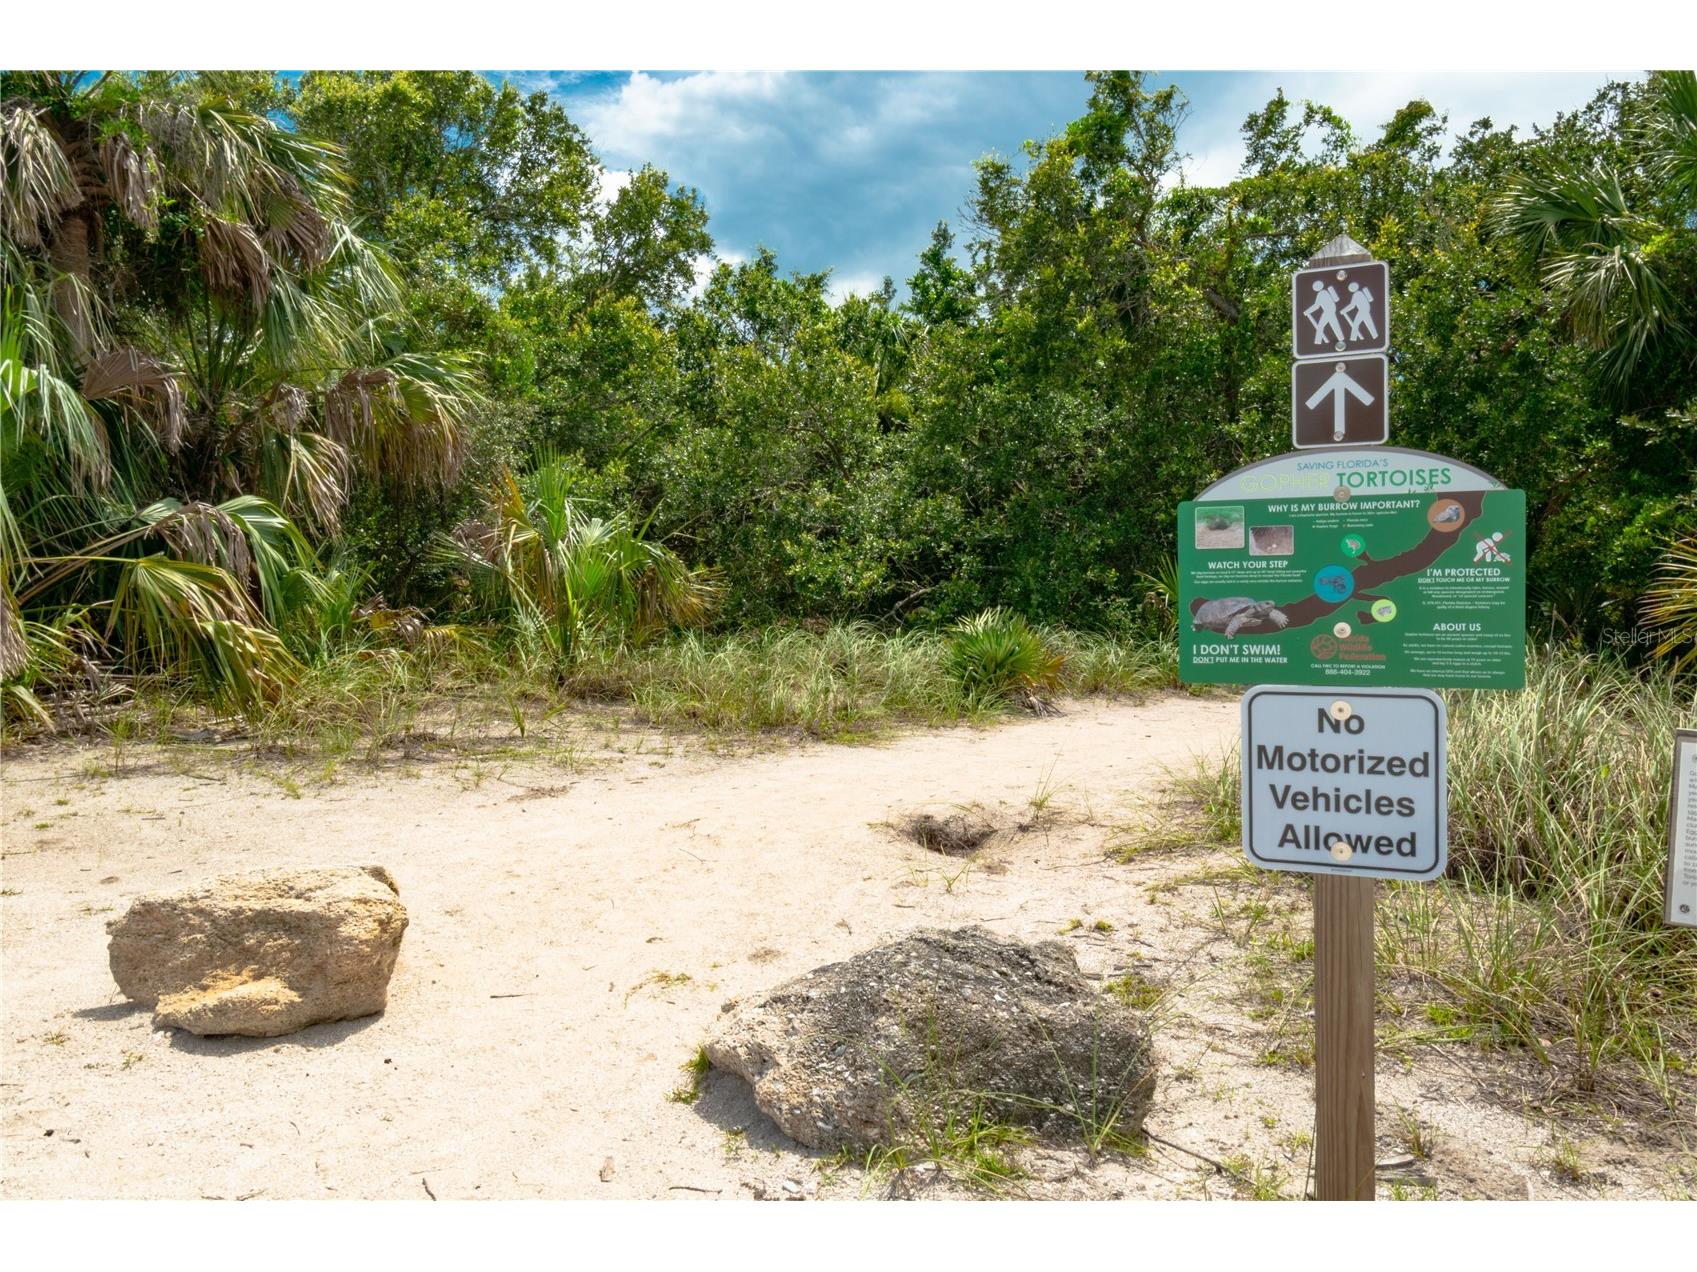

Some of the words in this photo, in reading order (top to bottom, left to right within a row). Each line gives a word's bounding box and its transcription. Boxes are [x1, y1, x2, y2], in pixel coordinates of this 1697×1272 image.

[1296, 461, 1334, 471] SAVING
[1337, 458, 1389, 469] FLORIDA'S
[1336, 468, 1452, 488] TORTOISES
[1268, 504, 1289, 513] WHY
[1291, 504, 1299, 512] IS
[1301, 503, 1315, 511] MY
[1318, 502, 1358, 511] BURROW
[1360, 500, 1421, 509] IMPORTANT?
[1208, 561, 1240, 570] WATCH
[1240, 560, 1267, 569] YOUR
[1269, 560, 1289, 569] STEP
[1427, 568, 1442, 577] I'M
[1445, 567, 1501, 577] PROTECTED
[1433, 623, 1466, 631] ABOUT
[1469, 623, 1481, 631] US
[1193, 645, 1197, 655] I
[1200, 644, 1239, 655] DON'T
[1242, 644, 1281, 655] SWIM!
[1317, 707, 1365, 735] No
[1256, 744, 1430, 778] Motorized
[1269, 783, 1416, 818] Vehicles
[1278, 823, 1417, 858] Allowed
